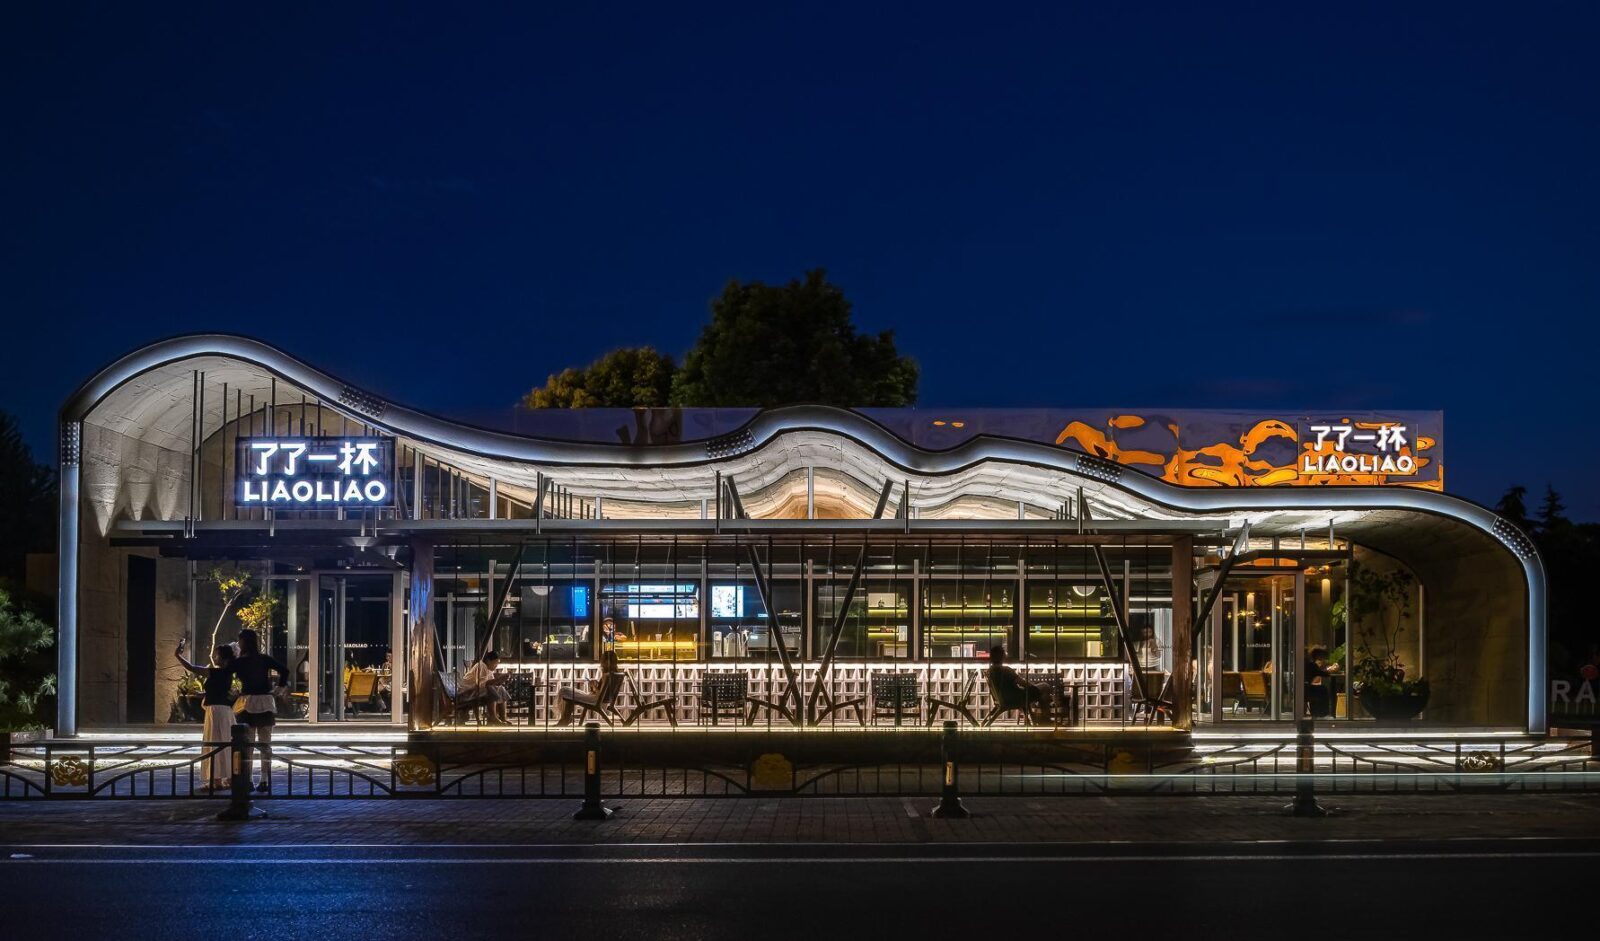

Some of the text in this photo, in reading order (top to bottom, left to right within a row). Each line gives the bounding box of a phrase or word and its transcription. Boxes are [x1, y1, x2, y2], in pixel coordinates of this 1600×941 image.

[1311, 425, 1406, 451] 了了一杯
[252, 442, 378, 475] 了了一杯
[1305, 455, 1413, 472] LIAOLIAO
[244, 480, 386, 502] LIAOLIAO
